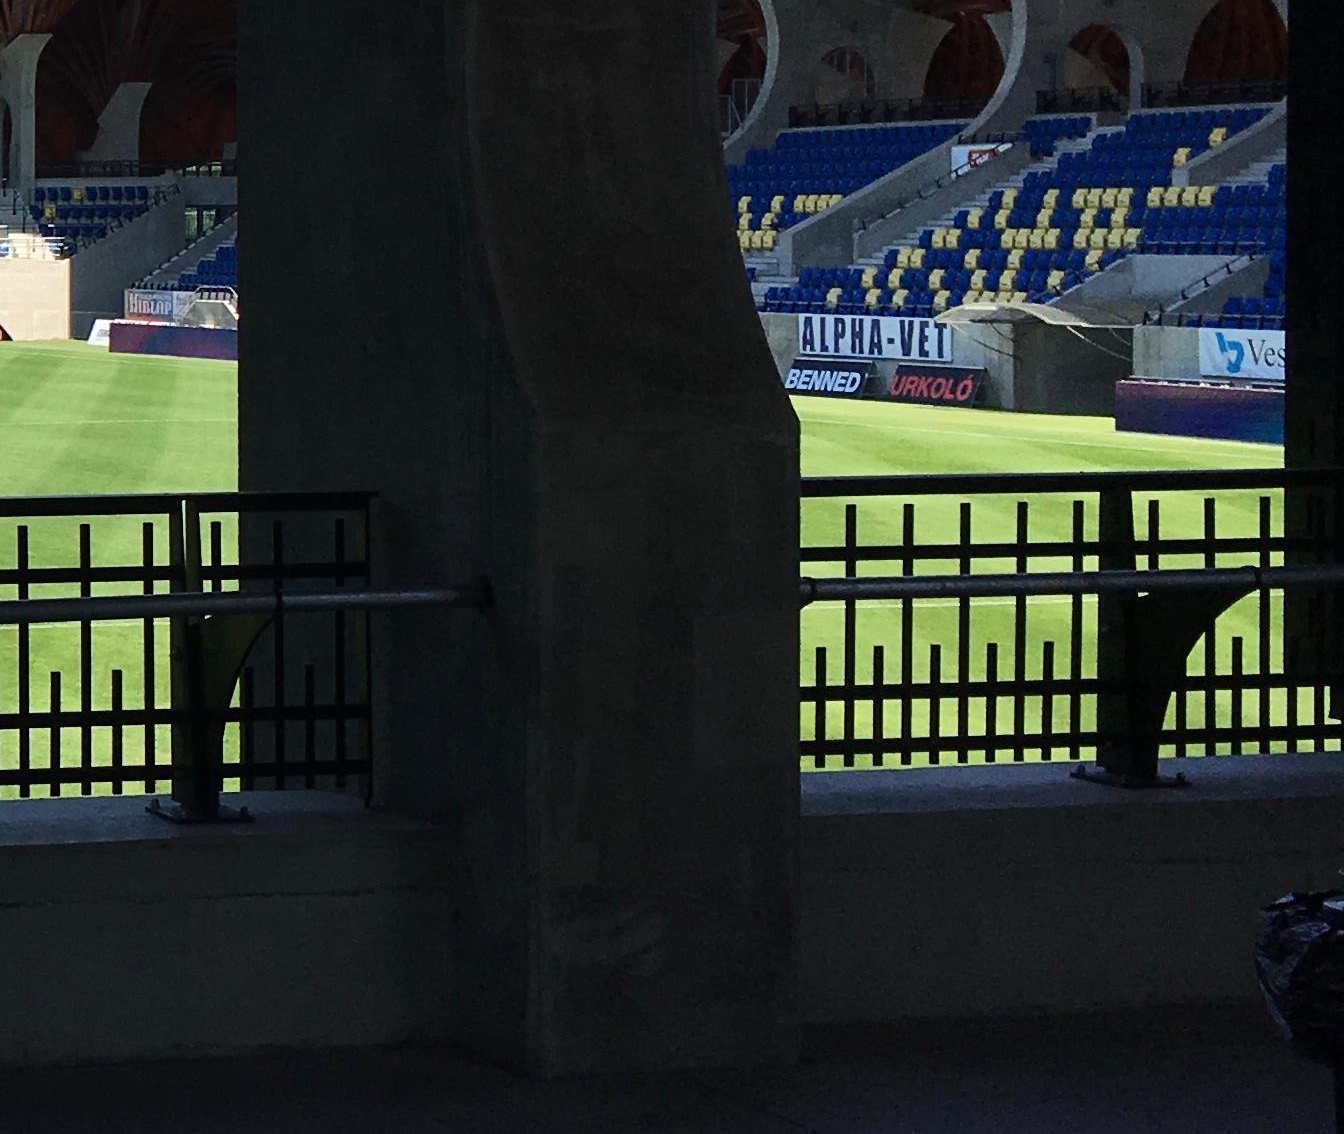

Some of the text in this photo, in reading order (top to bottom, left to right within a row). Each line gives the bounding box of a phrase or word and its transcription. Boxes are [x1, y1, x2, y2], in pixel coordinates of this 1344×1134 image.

[802, 316, 948, 358] ALPHA-VET
[785, 368, 862, 393] BENNED
[890, 373, 975, 402] URKOLÓ
